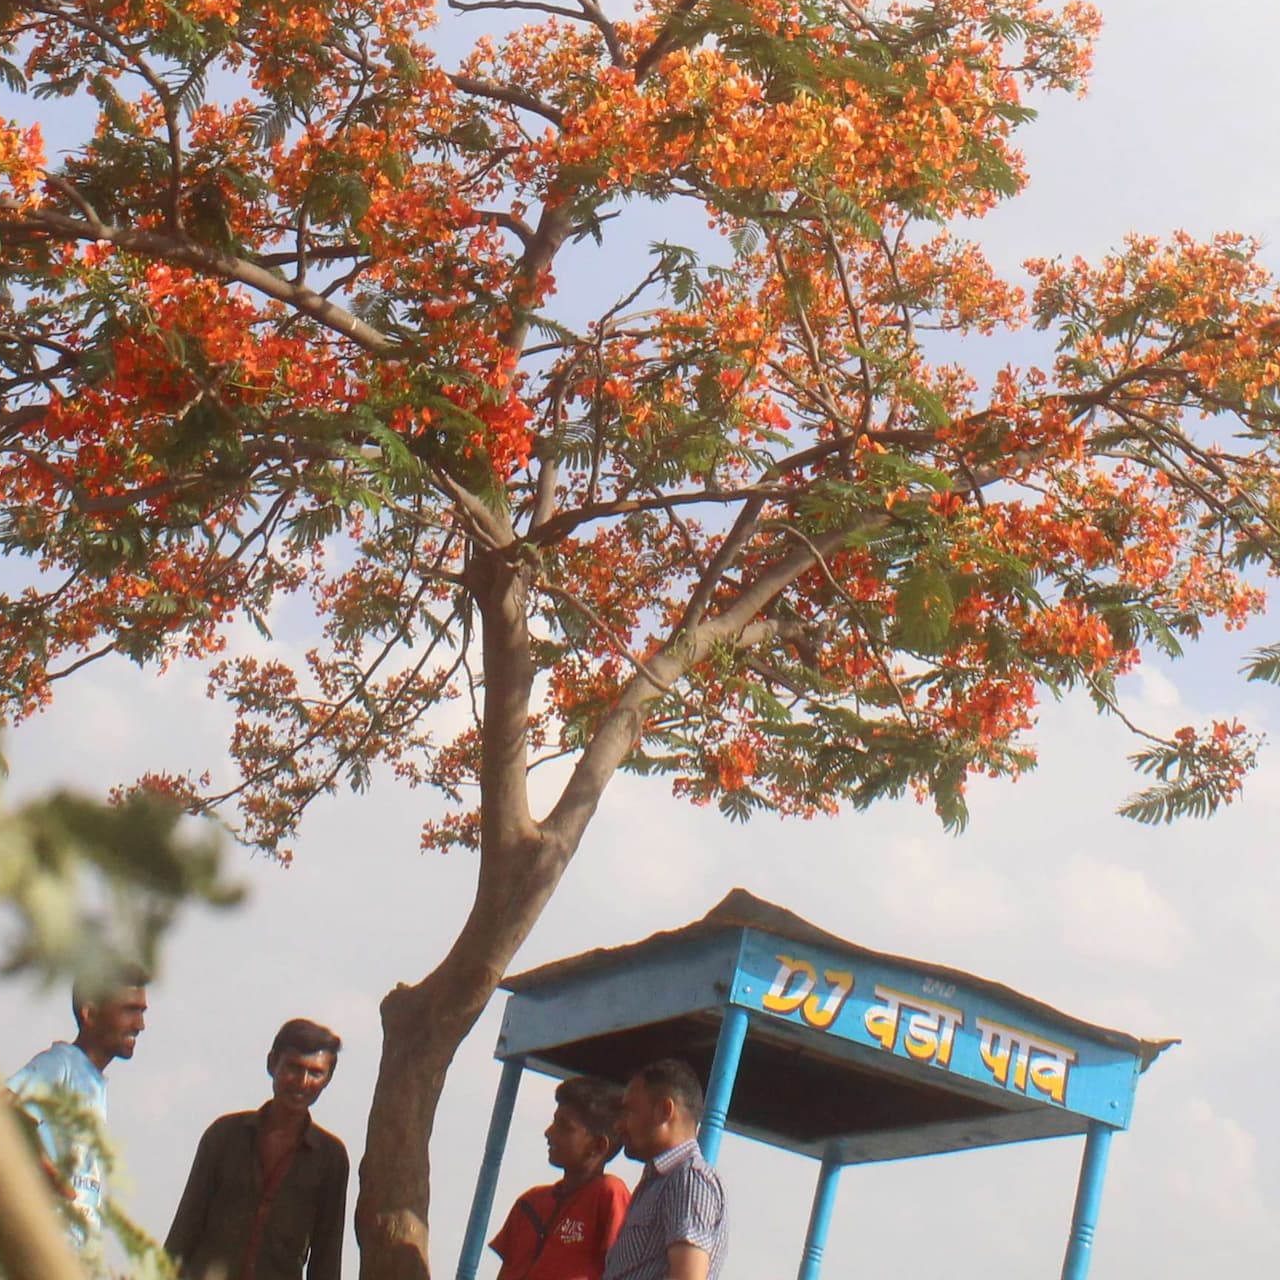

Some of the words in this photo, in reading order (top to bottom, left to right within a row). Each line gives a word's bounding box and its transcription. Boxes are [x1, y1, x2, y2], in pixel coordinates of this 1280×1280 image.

[762, 954, 854, 1030] DJ
[864, 984, 963, 1066] वडा
[975, 1018, 1077, 1107] पाव
